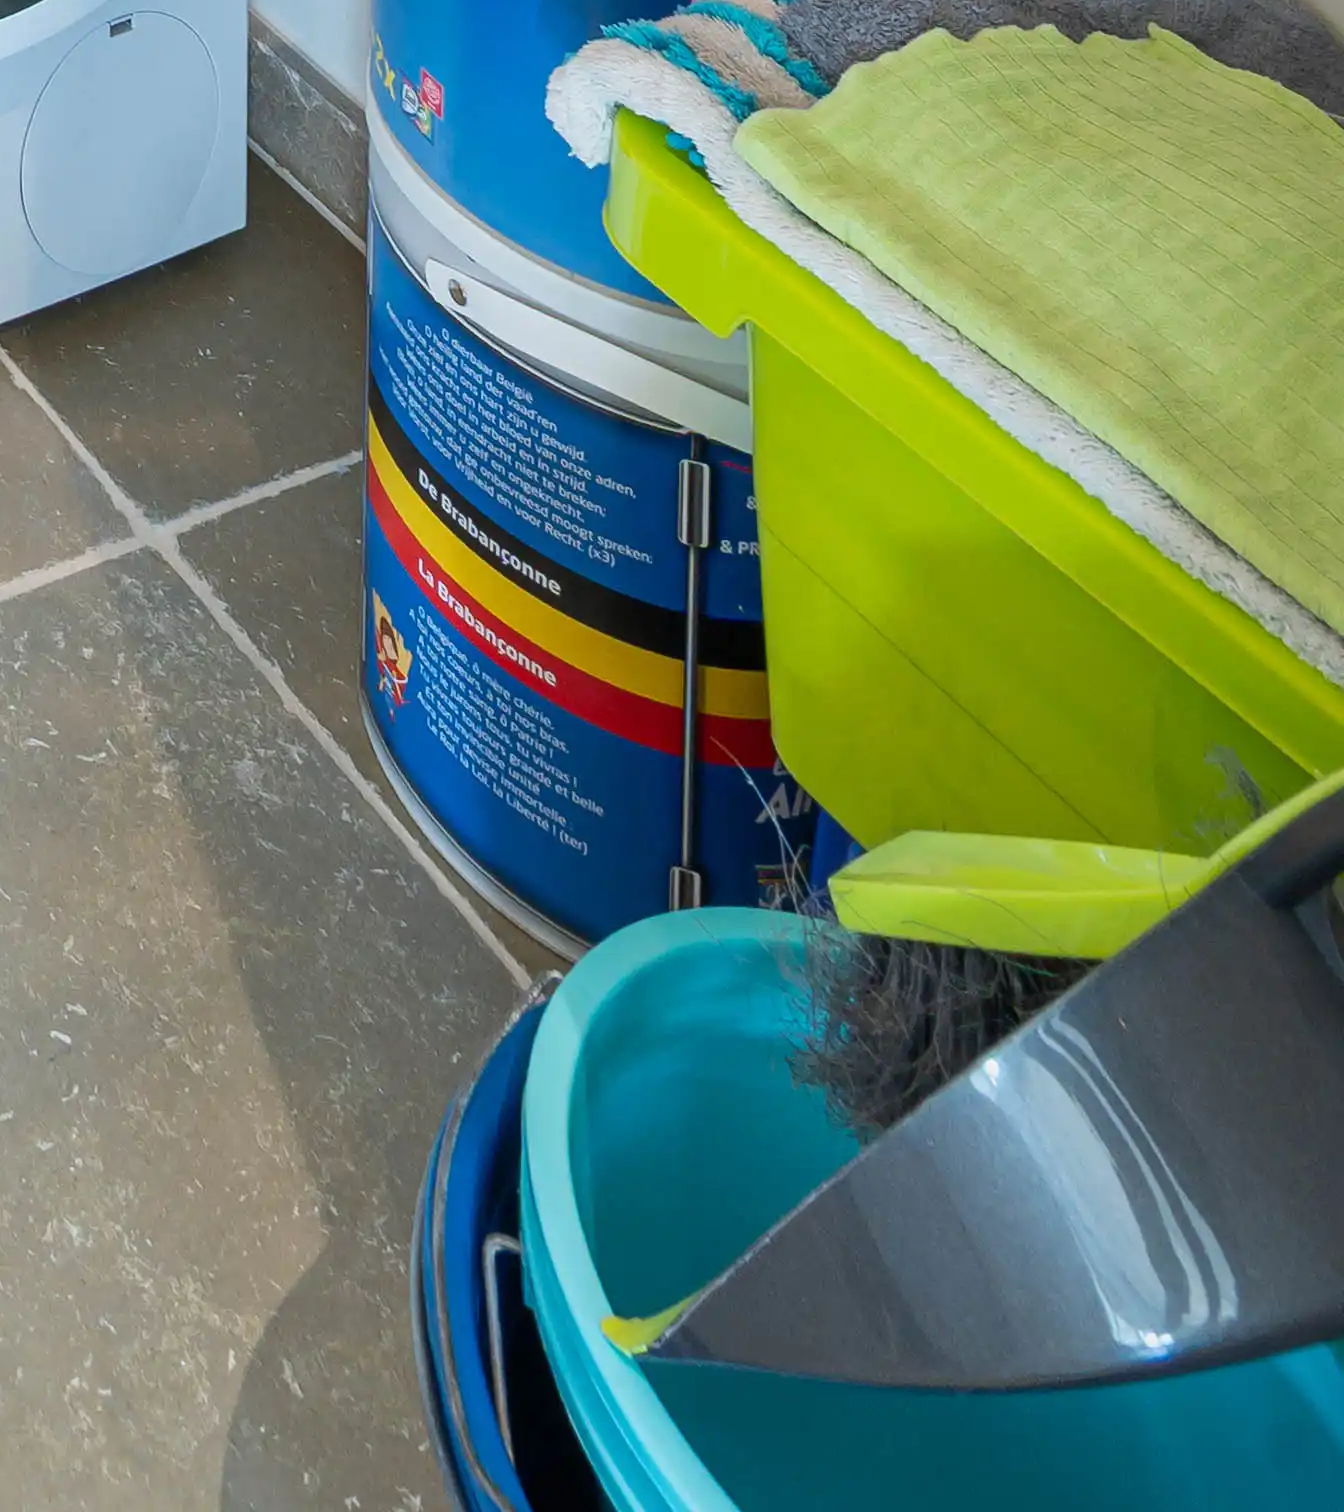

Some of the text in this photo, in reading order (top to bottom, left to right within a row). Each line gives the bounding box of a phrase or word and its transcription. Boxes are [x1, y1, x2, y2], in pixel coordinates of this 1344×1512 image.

[451, 337, 535, 403] dierbaar België
[560, 458, 593, 481] onze
[418, 467, 562, 596] De Brabançonne
[480, 466, 550, 519] onbevreesd
[551, 513, 595, 543] moogt
[514, 506, 543, 528] voor
[587, 544, 617, 569] (x3)
[417, 558, 557, 687] La Brabançonne
[510, 720, 549, 757] Patrie
[514, 713, 538, 735] nos
[508, 752, 605, 818] grande belle
[532, 753, 571, 784] vivras
[500, 774, 567, 829] immortelle
[506, 792, 589, 855] Liberté (ter)
